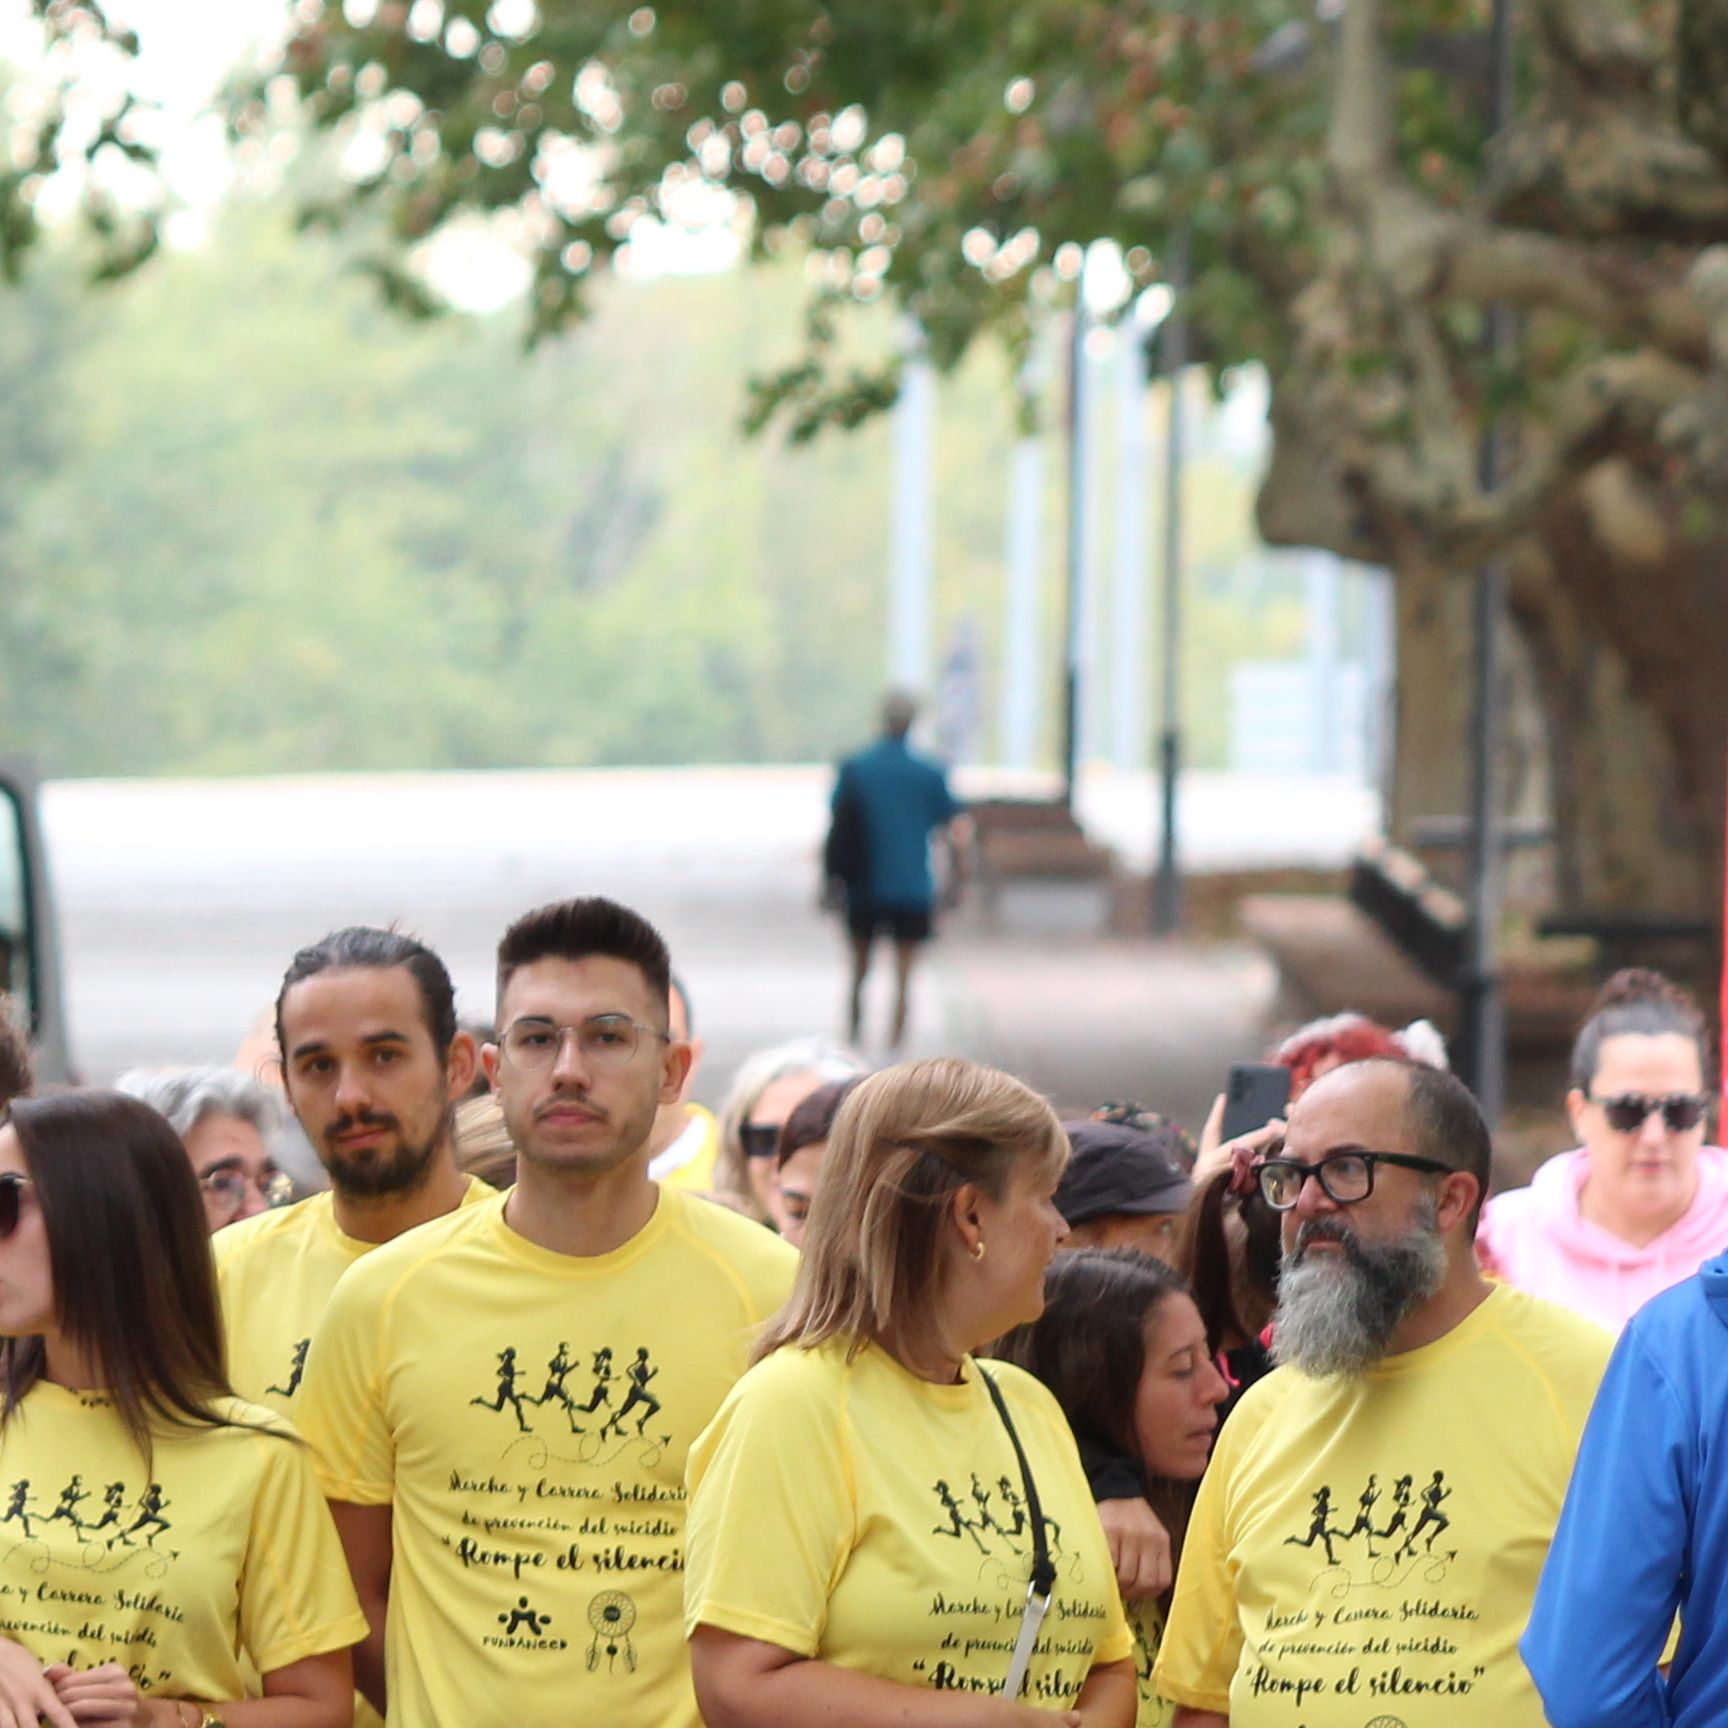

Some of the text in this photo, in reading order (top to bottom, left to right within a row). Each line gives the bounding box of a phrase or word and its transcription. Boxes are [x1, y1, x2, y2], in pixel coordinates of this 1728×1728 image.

[517, 1484, 529, 1502] y
[535, 1478, 603, 1499] Carrera
[611, 1481, 687, 1503] Solidari
[579, 1517, 609, 1535] del
[556, 1543, 586, 1571] el
[592, 1545, 684, 1574] silenci
[19, 1587, 29, 1602] y
[37, 1581, 106, 1605] Carrera
[114, 1589, 186, 1623] Solidaria
[929, 1593, 990, 1618] Marcha
[994, 1604, 1002, 1623] y
[1315, 1610, 1327, 1629] y
[1400, 1599, 1480, 1622] Solidaria
[77, 1620, 107, 1641] del
[941, 1632, 962, 1649] de
[1362, 1637, 1391, 1654] del
[1395, 1636, 1459, 1656] suicidio
[1334, 1666, 1361, 1696] el
